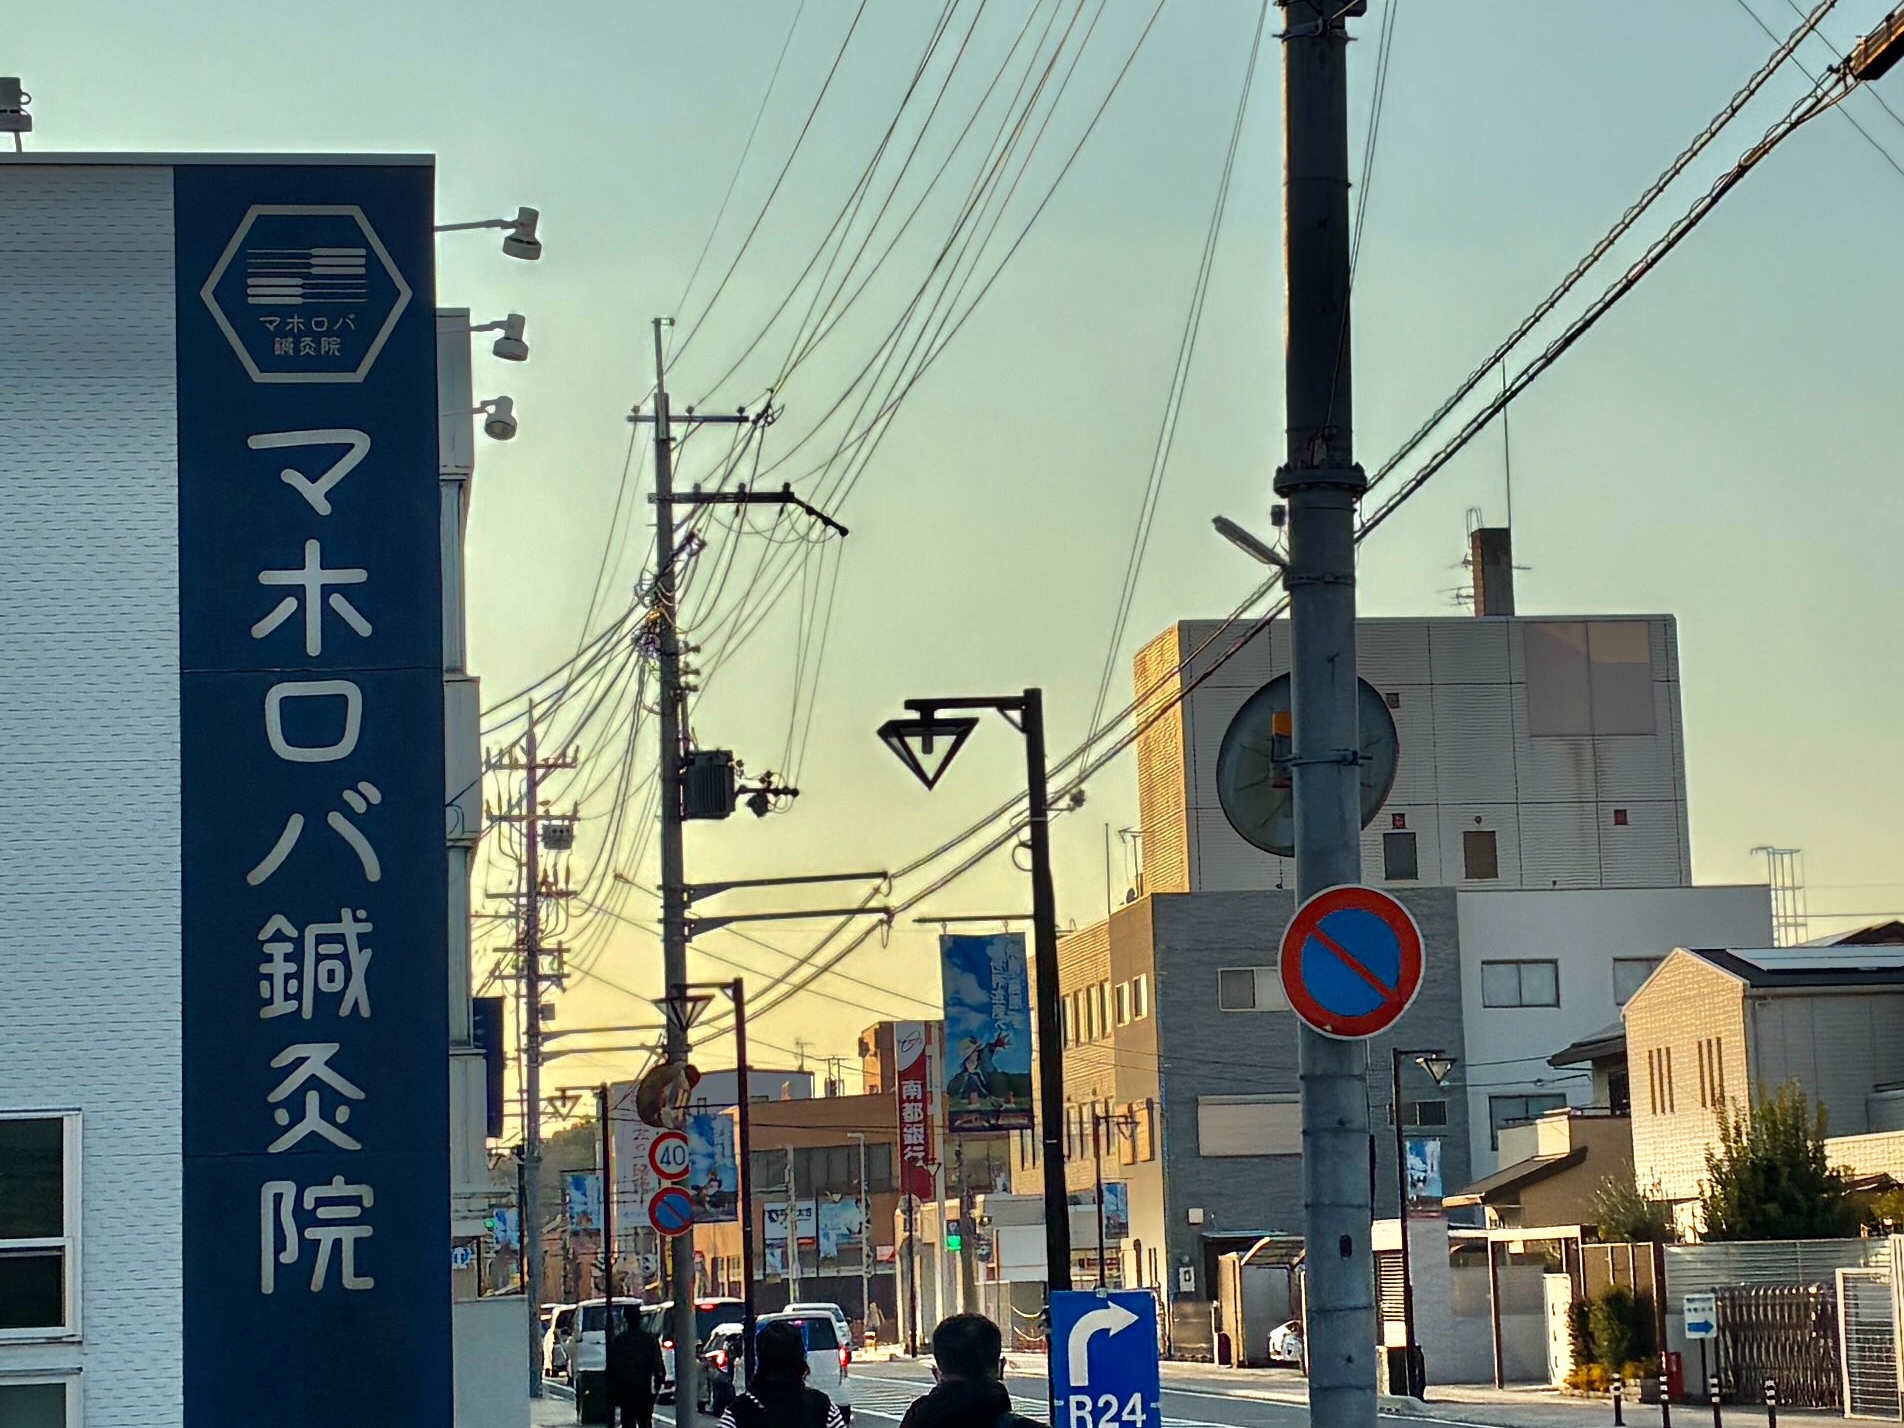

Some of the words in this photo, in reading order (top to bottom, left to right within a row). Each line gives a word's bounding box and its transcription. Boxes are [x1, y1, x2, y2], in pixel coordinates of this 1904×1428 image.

[258, 313, 356, 333] マホロバ
[274, 336, 341, 356] 鍼灸院
[246, 428, 383, 1295] マホロバ鍼灸院
[659, 1145, 687, 1167] 40
